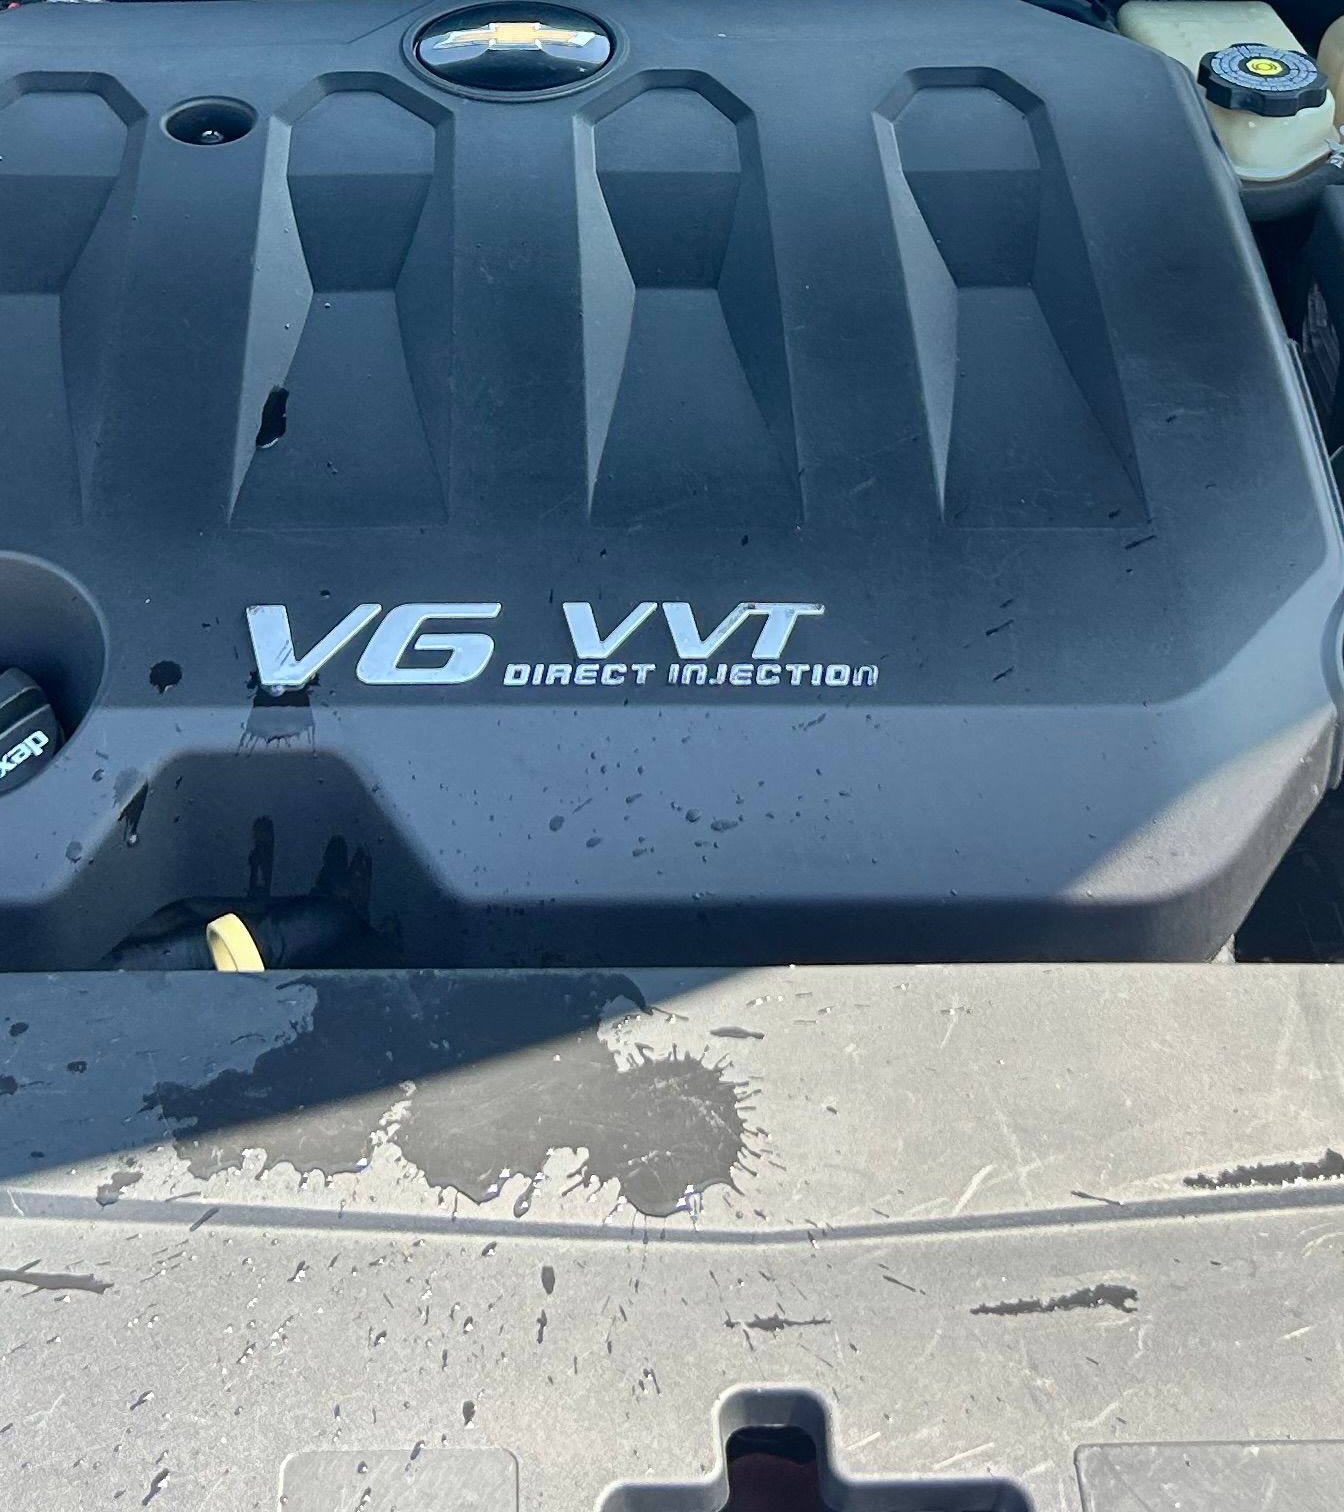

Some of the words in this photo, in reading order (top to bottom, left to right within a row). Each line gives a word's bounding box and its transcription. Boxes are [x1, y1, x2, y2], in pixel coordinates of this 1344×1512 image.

[245, 601, 502, 687] V6
[561, 600, 826, 660] VVT
[502, 662, 656, 687] DIRECT
[666, 662, 880, 688] INJECTION
